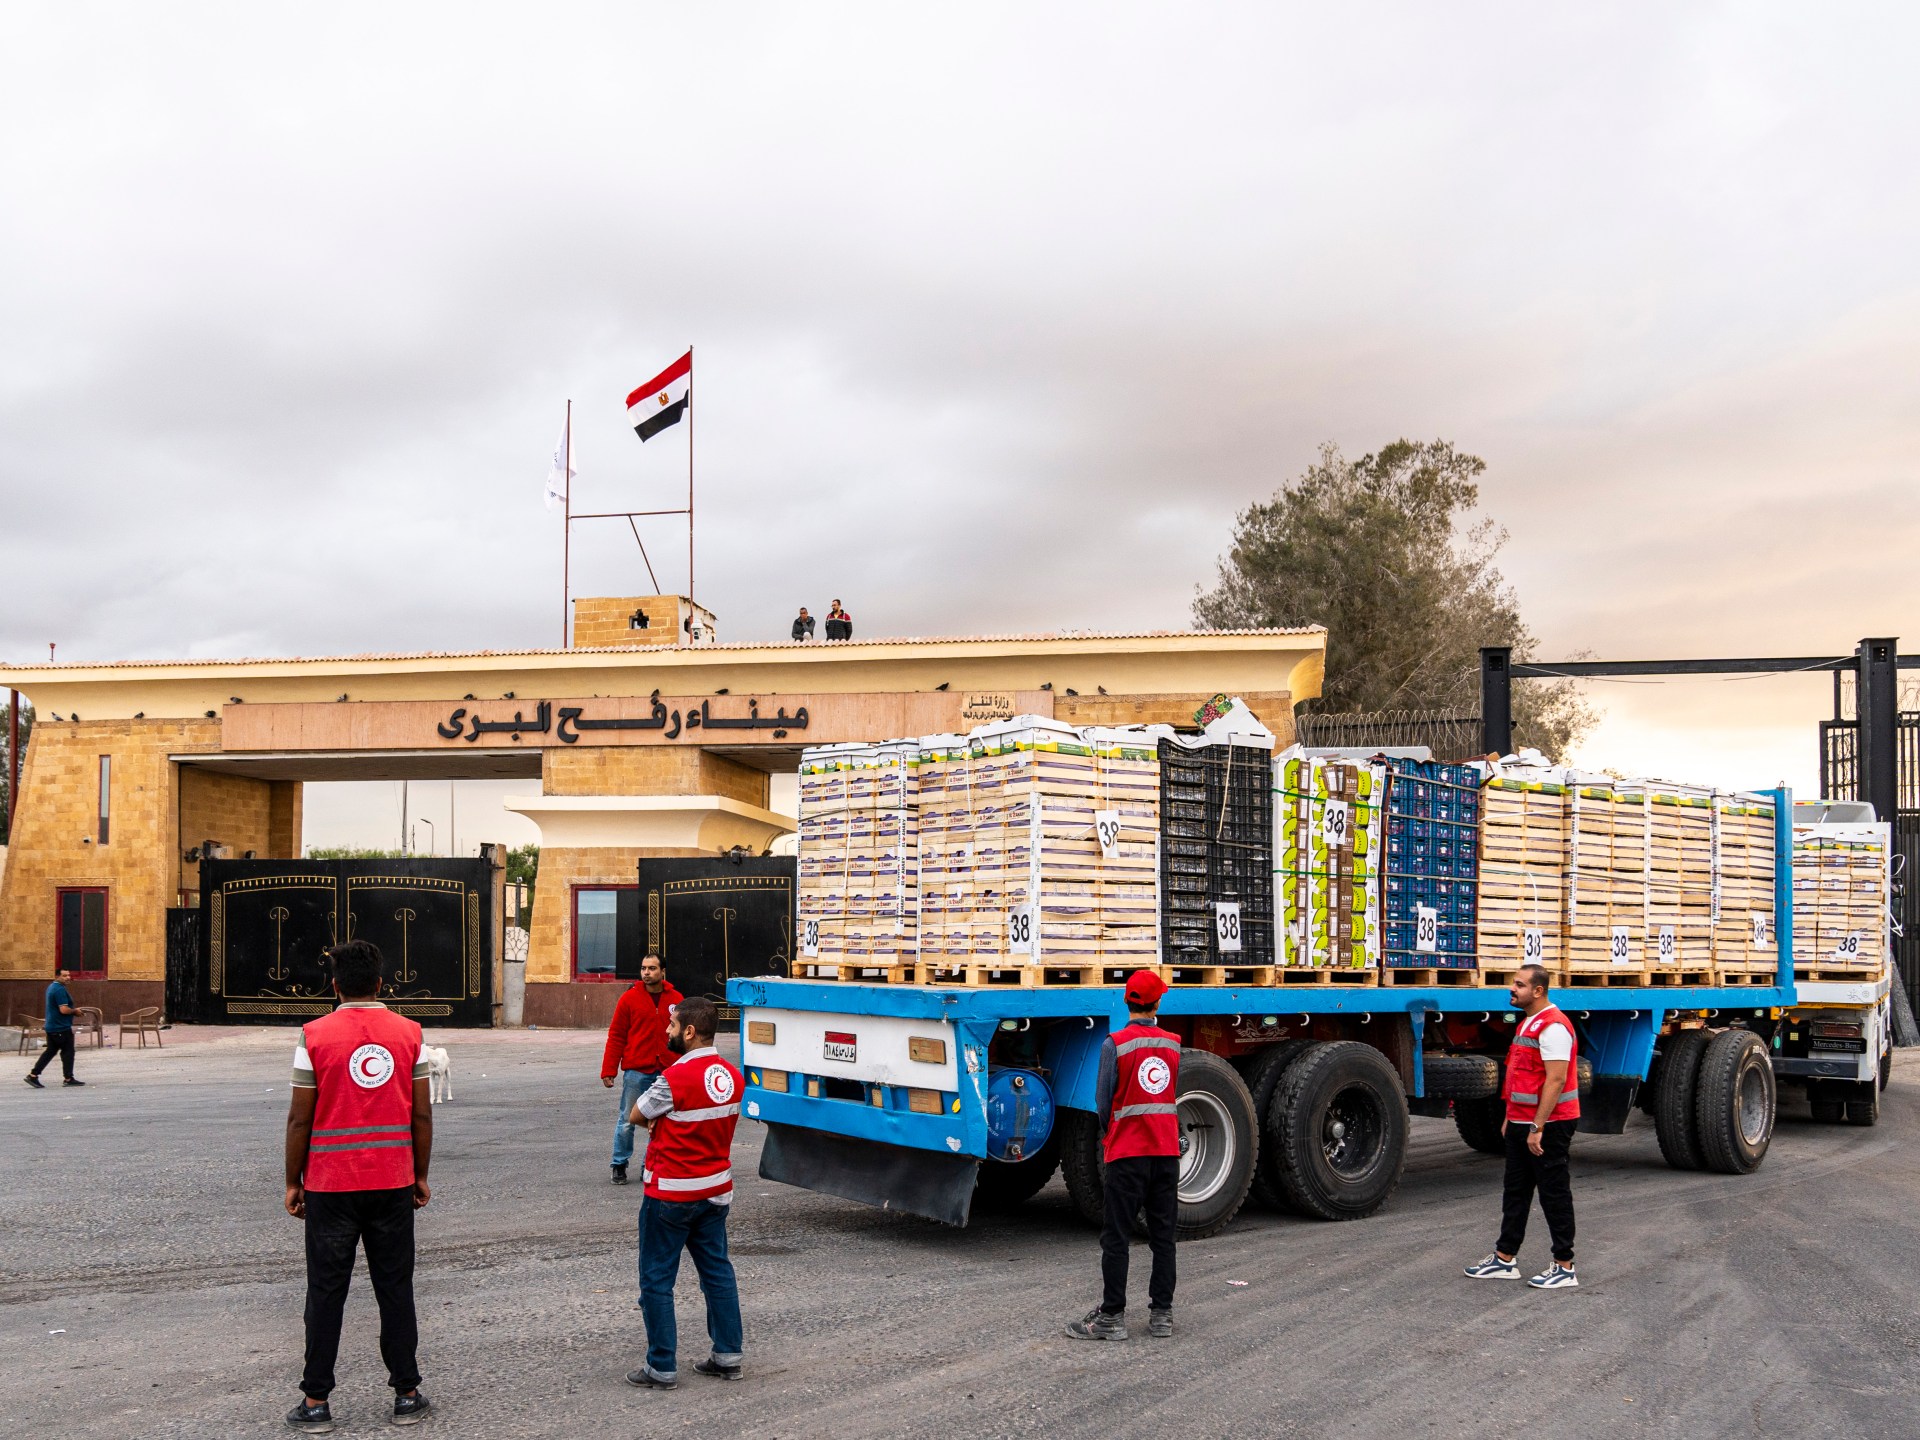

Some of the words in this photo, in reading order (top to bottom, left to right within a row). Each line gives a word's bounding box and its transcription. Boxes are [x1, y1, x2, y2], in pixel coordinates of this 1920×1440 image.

[557, 697, 680, 743] رفح
[686, 699, 809, 739] ميناء
[1325, 808, 1344, 836] 38
[806, 921, 818, 946] 38
[1011, 914, 1029, 942] 38
[1219, 913, 1238, 939] 38
[1419, 917, 1434, 941] 38
[1614, 935, 1627, 956] 38
[1661, 934, 1672, 954] 38
[1839, 936, 1857, 952] 38
[1813, 1040, 1861, 1049] Mercedes-Benz
